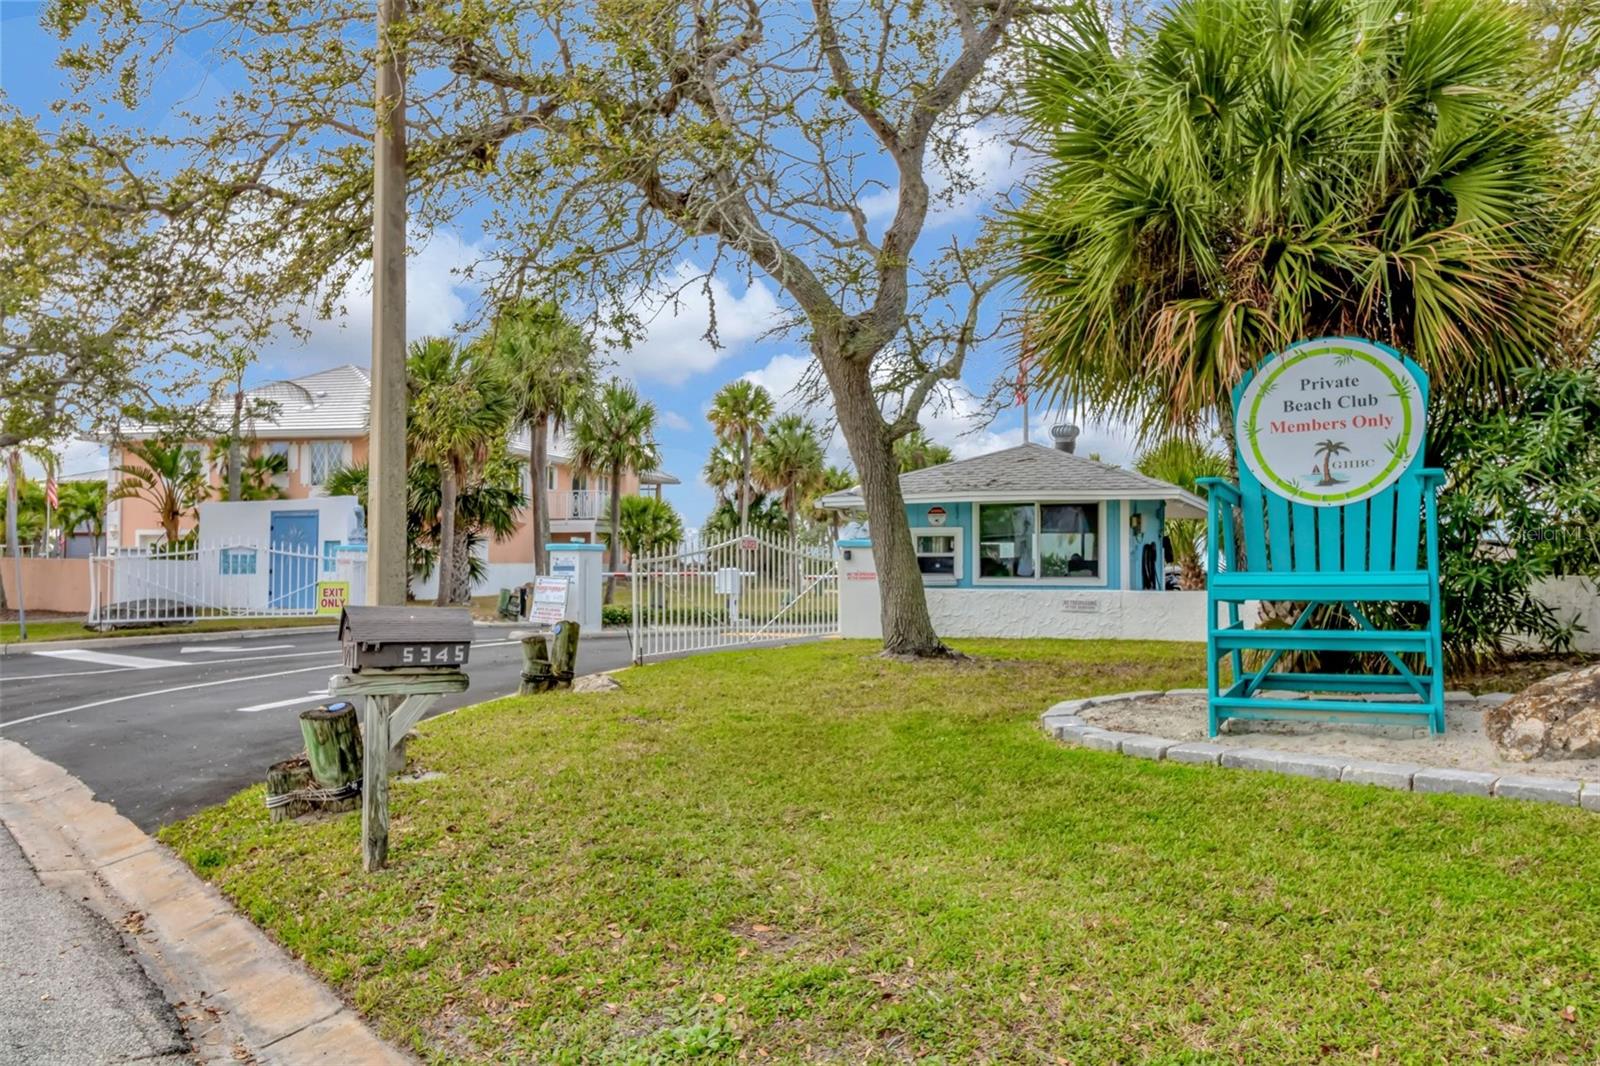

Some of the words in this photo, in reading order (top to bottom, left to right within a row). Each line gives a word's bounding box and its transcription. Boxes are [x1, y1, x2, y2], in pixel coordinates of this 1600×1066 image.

[1300, 376, 1360, 392] Private
[1283, 397, 1332, 413] Beach
[1337, 393, 1379, 409] Club
[1269, 418, 1347, 434] Members
[1351, 413, 1393, 430] Only
[322, 587, 344, 598] EXIT
[320, 598, 345, 608] ONLY
[402, 645, 465, 663] 5345
